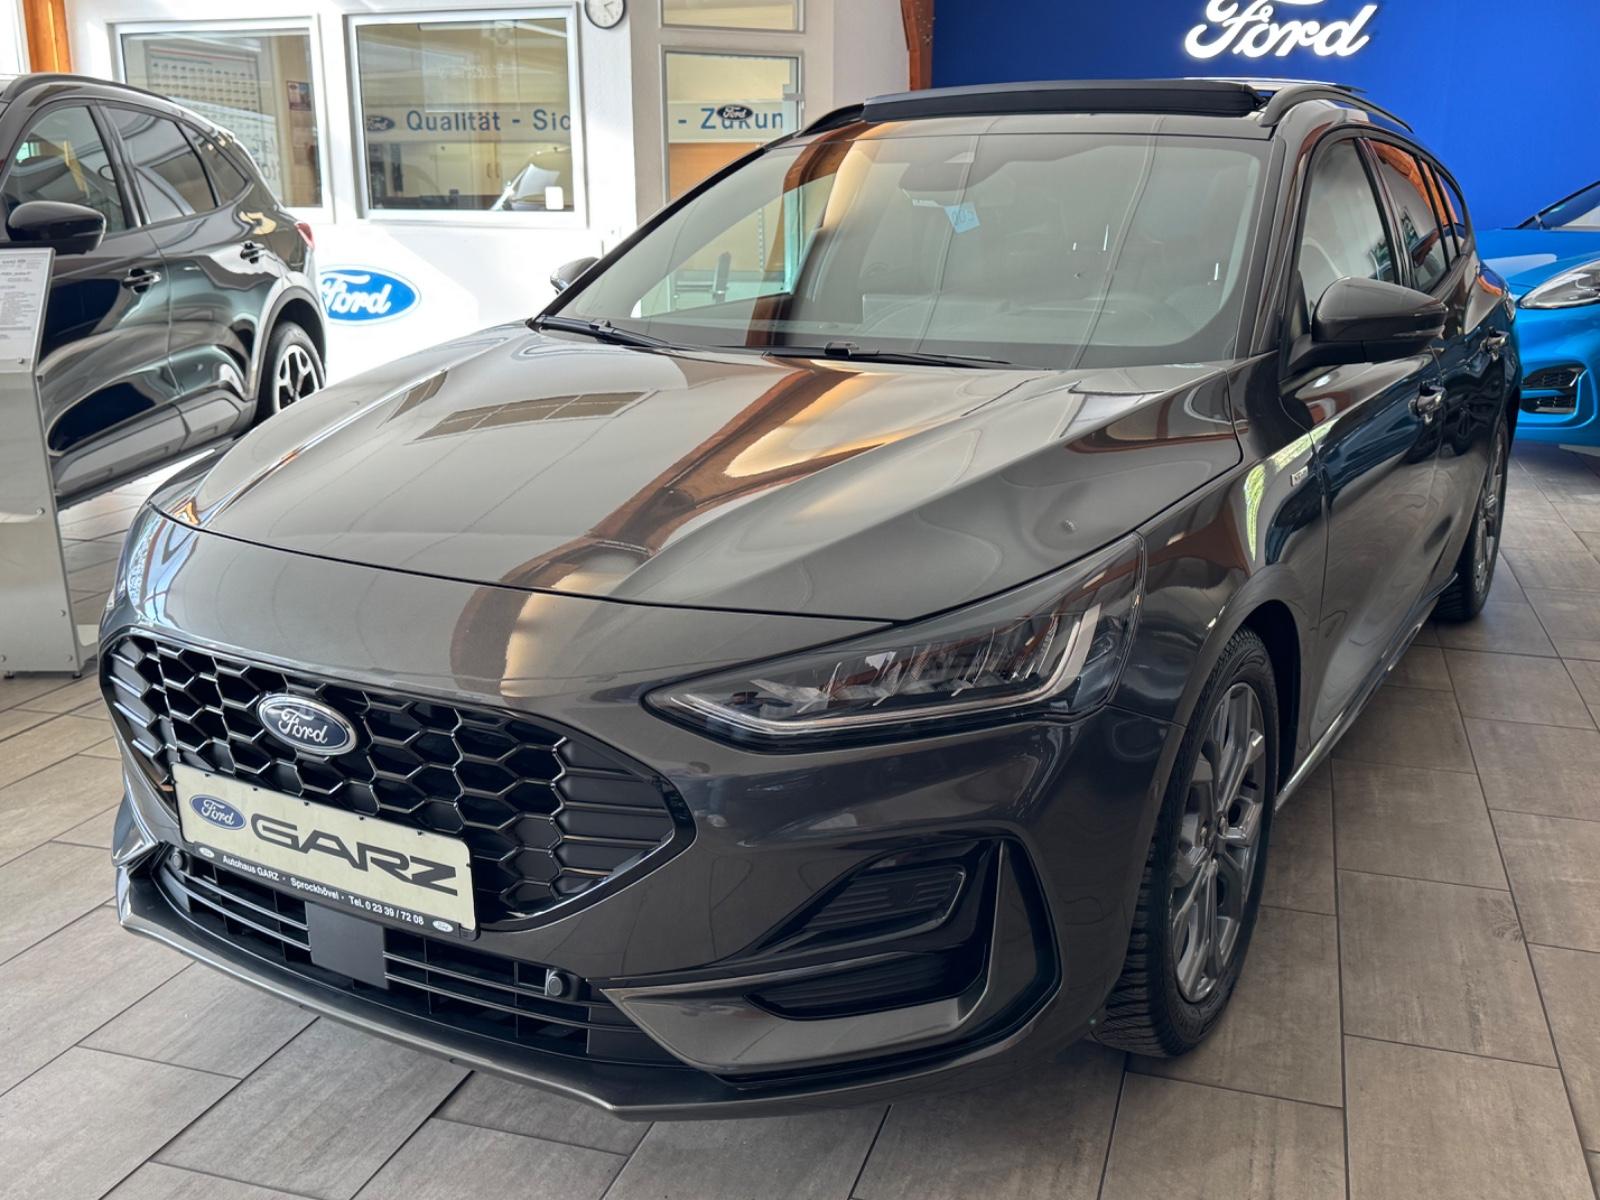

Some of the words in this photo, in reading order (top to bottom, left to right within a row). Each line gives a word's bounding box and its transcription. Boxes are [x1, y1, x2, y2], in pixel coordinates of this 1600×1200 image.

[1184, 0, 1378, 58] Ford
[406, 109, 502, 131] Qualität
[532, 108, 571, 131] Sic
[277, 707, 329, 744] Ford
[200, 798, 235, 826] Ford
[250, 813, 458, 896] GARZ
[222, 855, 256, 874] Autohaus
[257, 866, 280, 881] GARZ
[348, 895, 364, 908] Tel.
[372, 902, 382, 913] 23
[401, 911, 412, 922] 72
